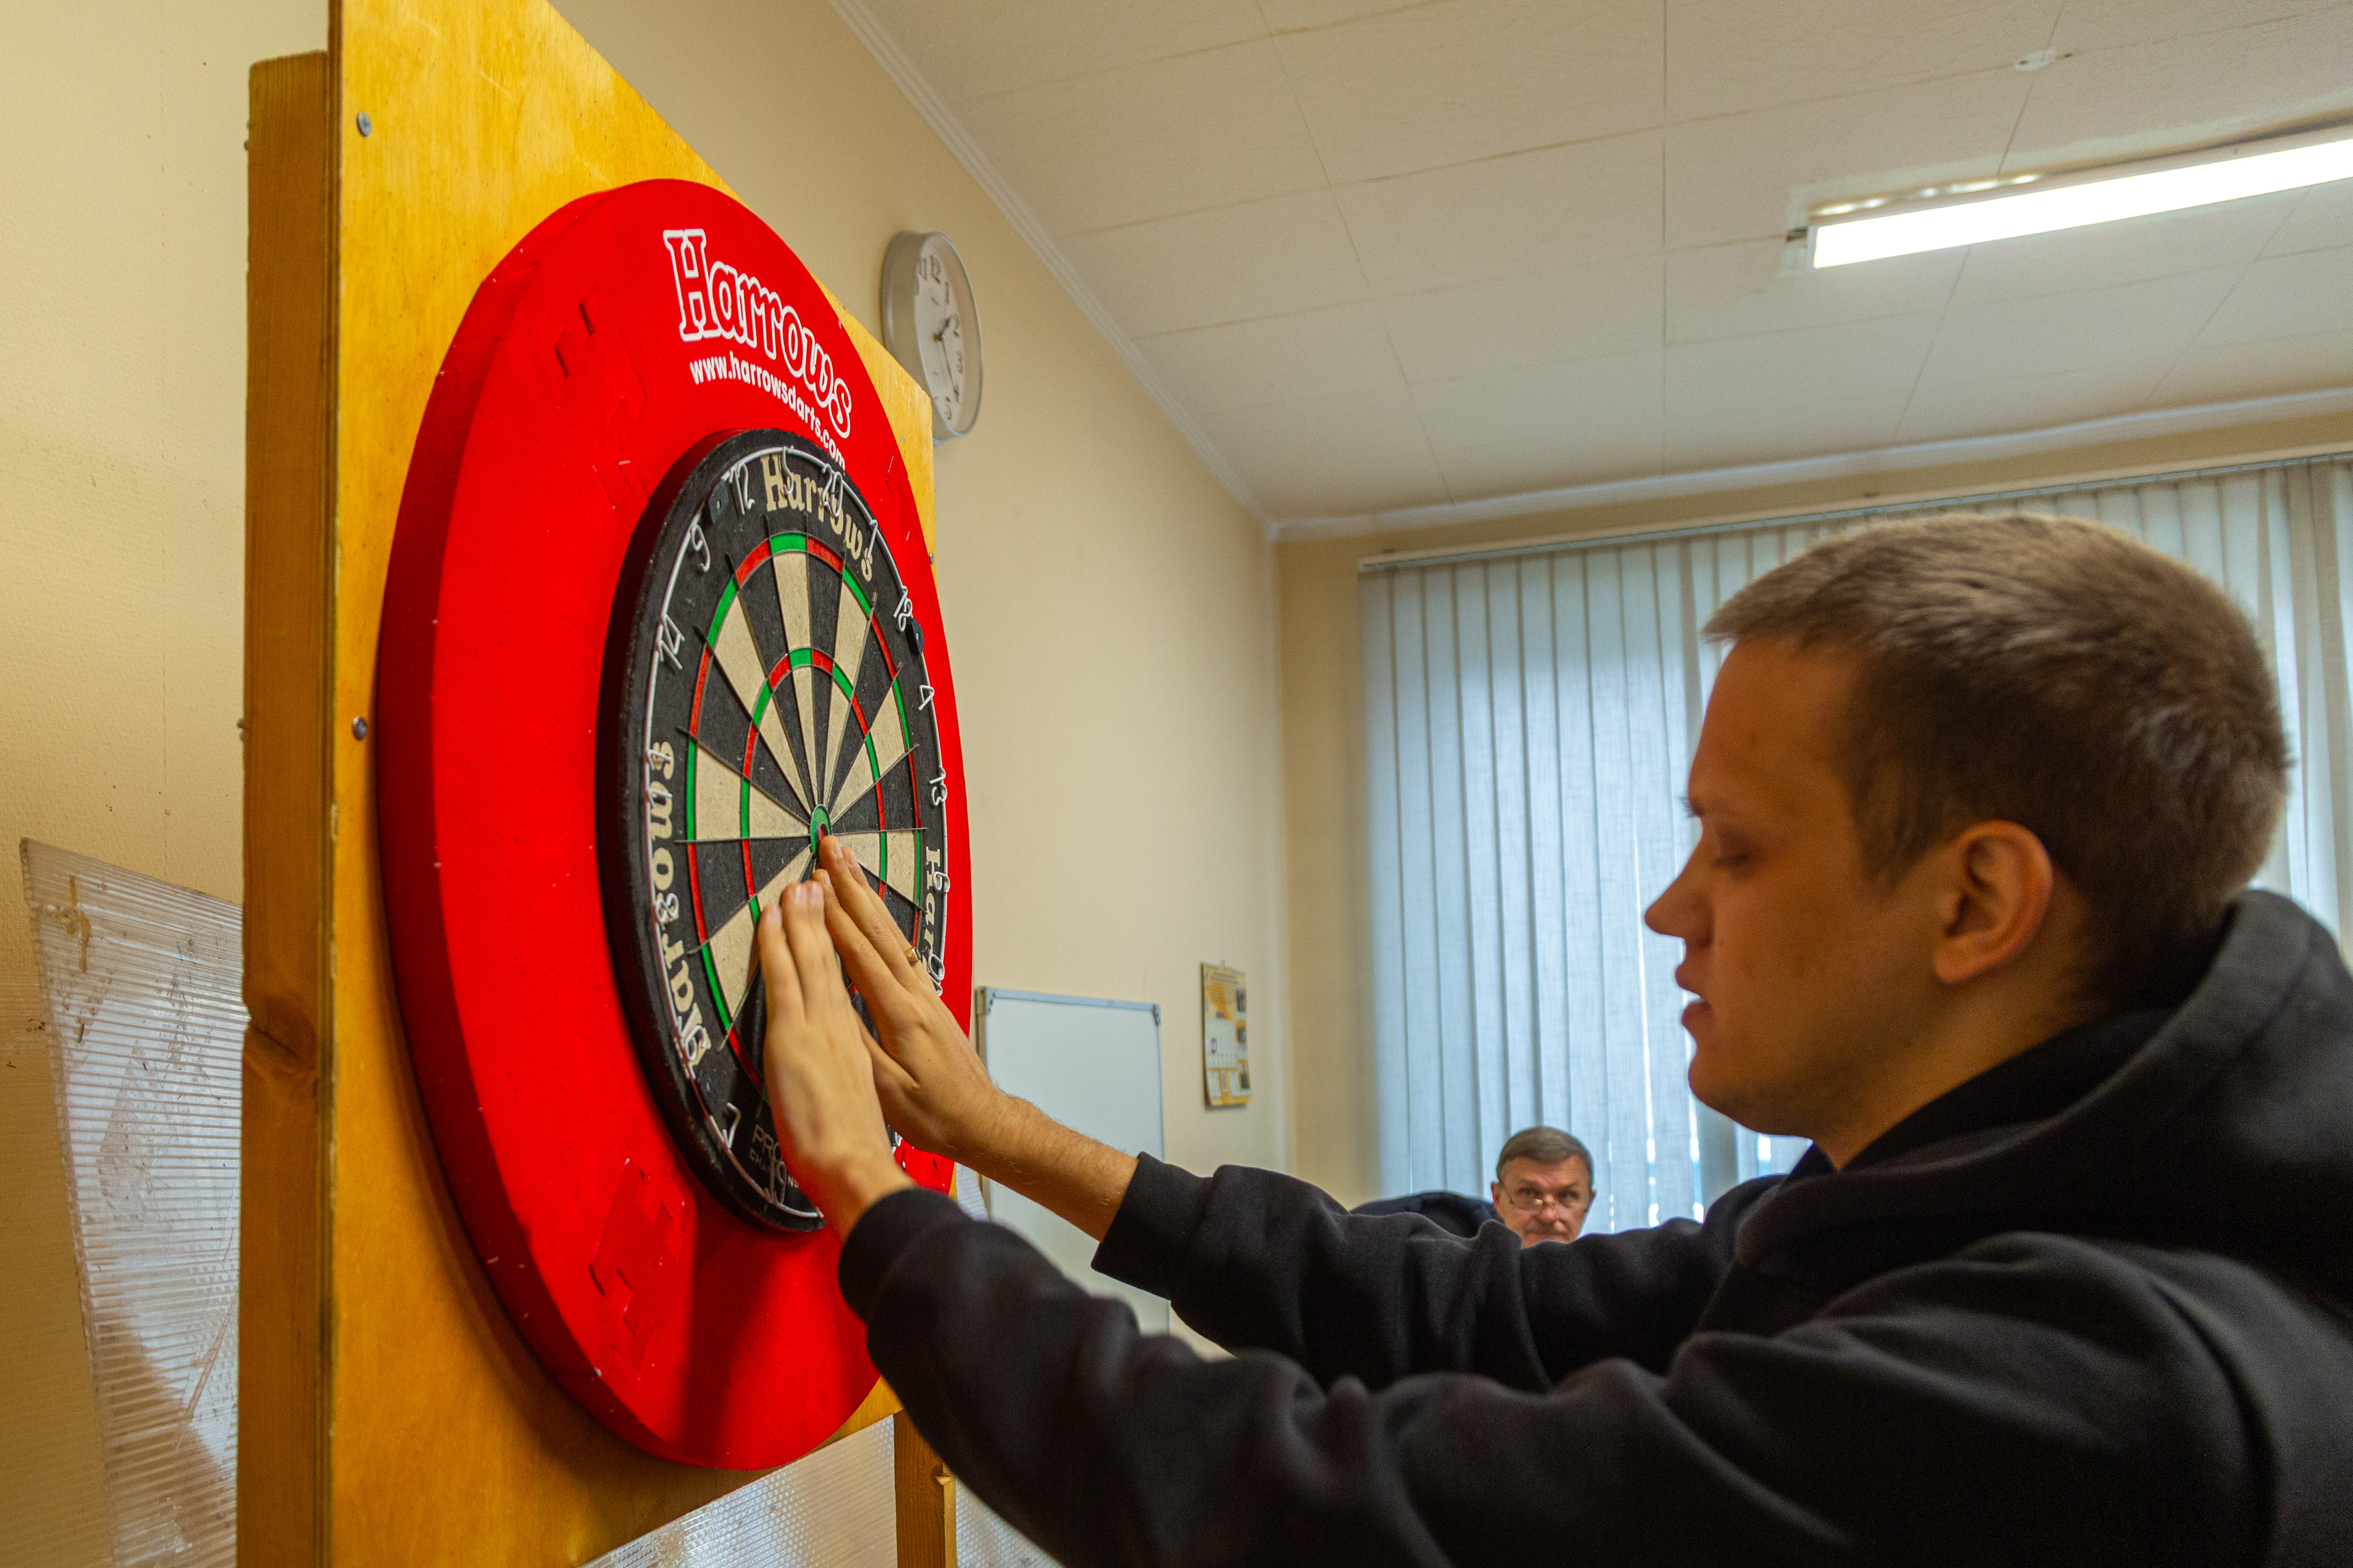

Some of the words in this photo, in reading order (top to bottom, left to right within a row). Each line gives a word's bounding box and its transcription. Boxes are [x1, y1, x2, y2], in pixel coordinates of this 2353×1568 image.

[663, 228, 852, 439] Harrows
[690, 350, 846, 472] www.harrowsdarts.com
[821, 463, 843, 517] 20
[760, 454, 873, 581] Harrows
[692, 524, 710, 572] 9
[893, 585, 913, 632] 18
[658, 614, 685, 670] 14
[929, 766, 948, 807] 13
[655, 892, 679, 924] 8
